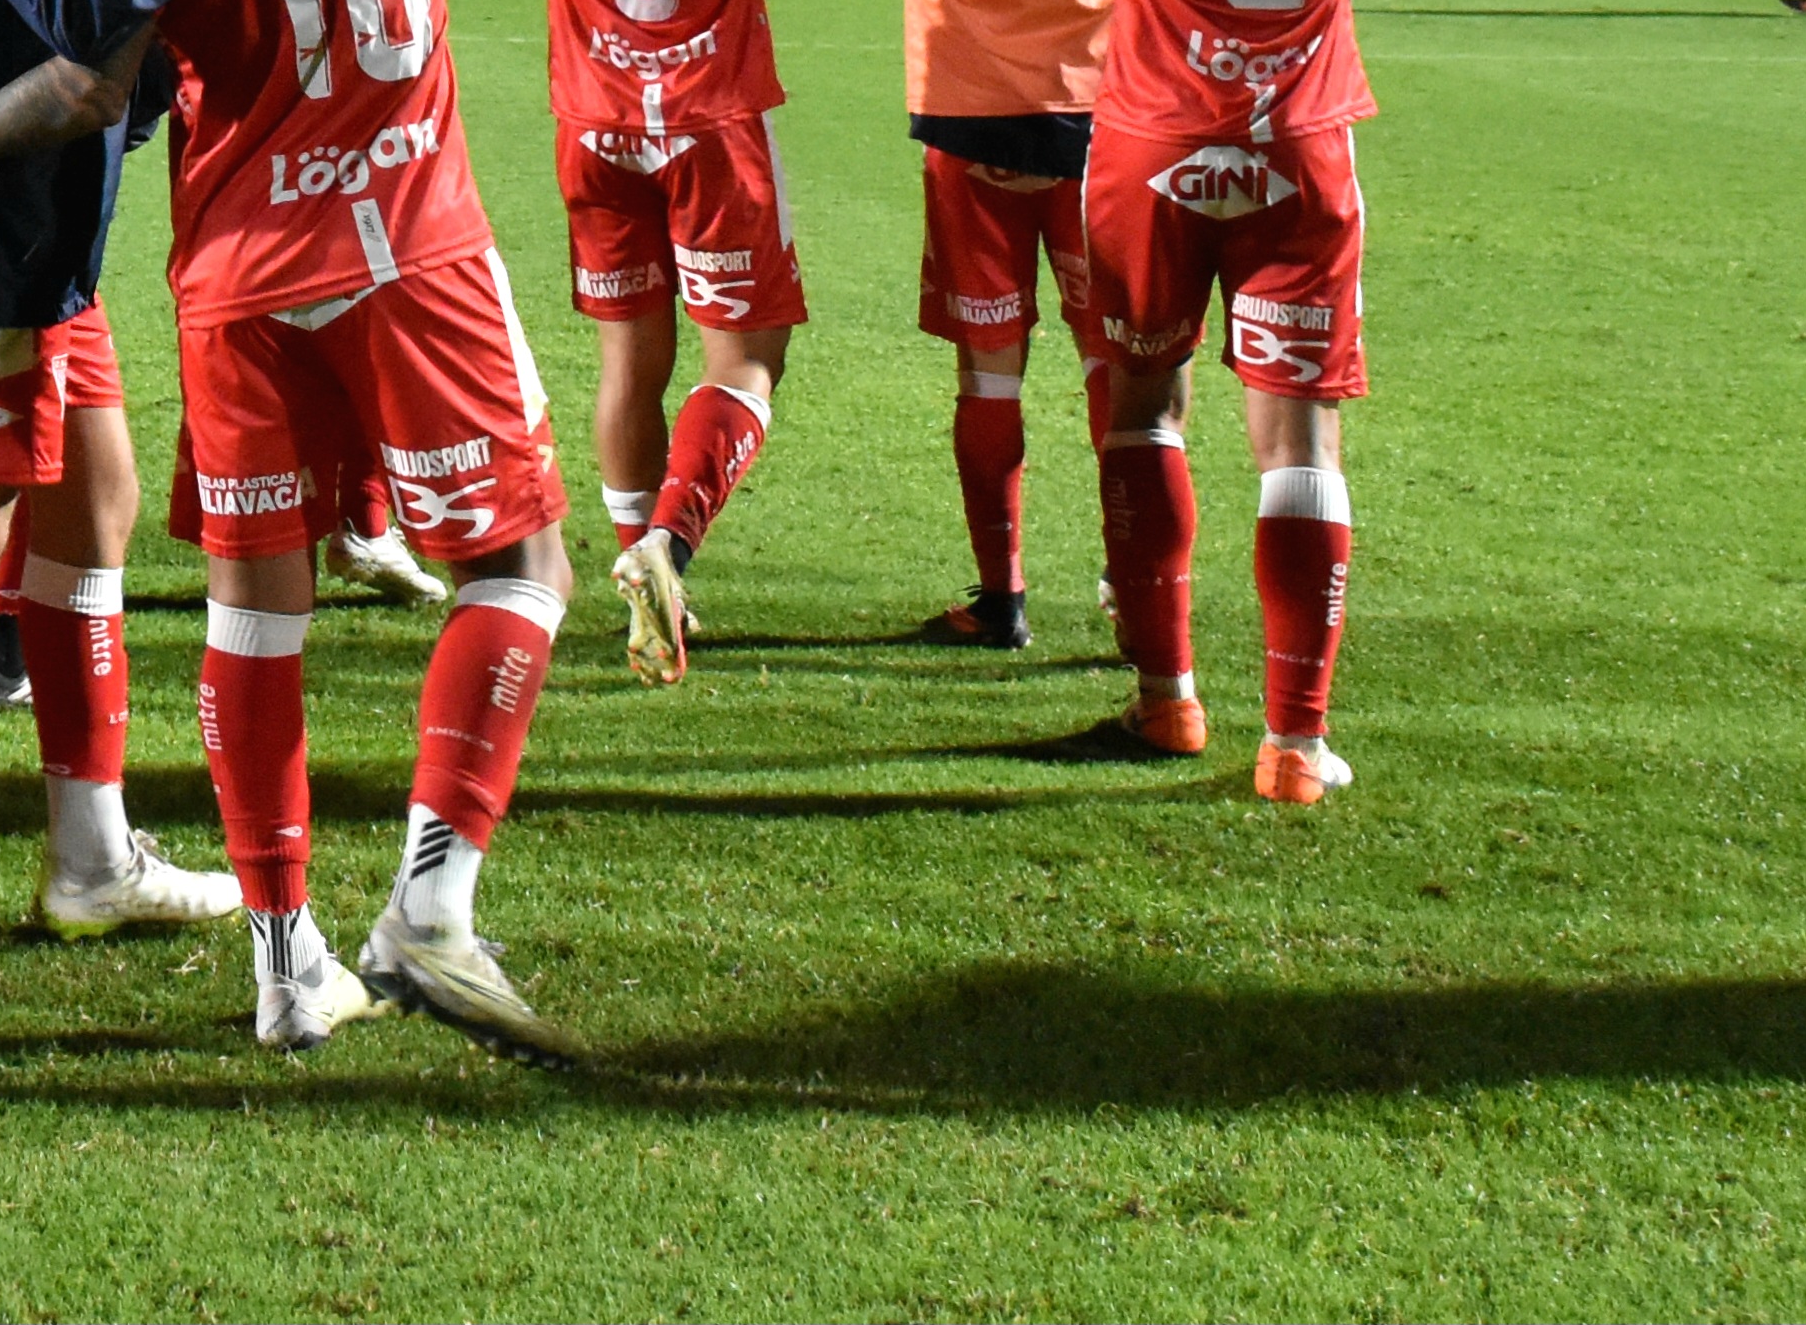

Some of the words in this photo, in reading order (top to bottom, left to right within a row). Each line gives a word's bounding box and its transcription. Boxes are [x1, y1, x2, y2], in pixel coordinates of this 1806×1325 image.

[1232, 292, 1333, 333] BRUJOSPORT
[228, 470, 297, 490] PLASTICAS
[1326, 561, 1349, 629] mitre
[490, 645, 533, 714] mitre
[197, 682, 222, 751] mitre
